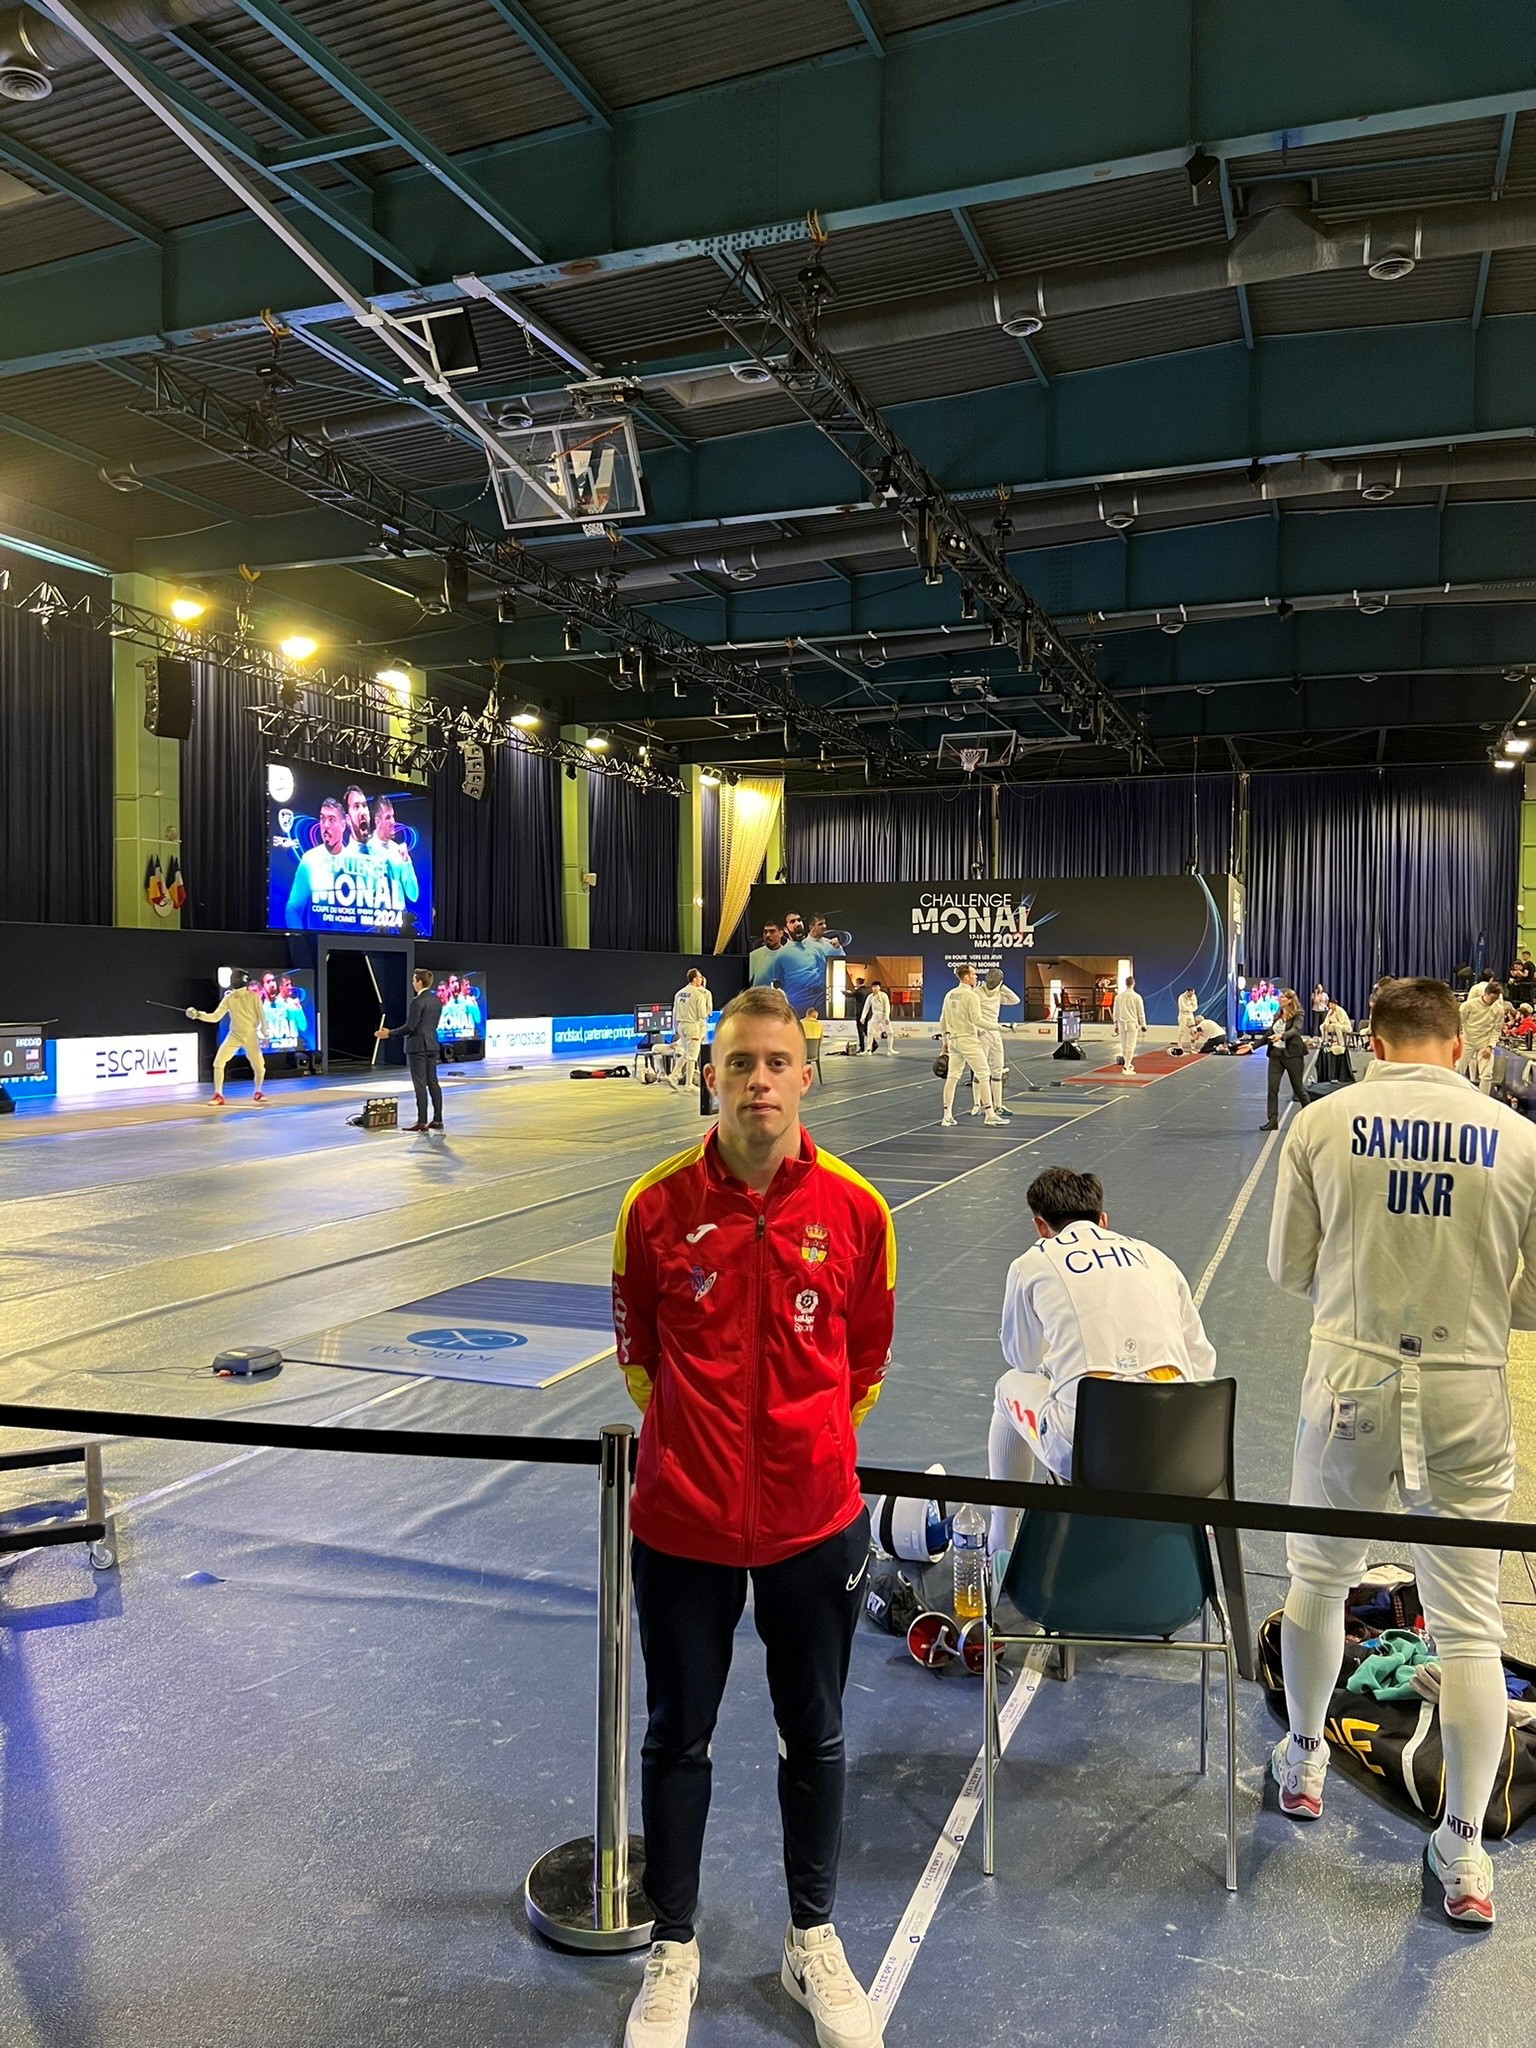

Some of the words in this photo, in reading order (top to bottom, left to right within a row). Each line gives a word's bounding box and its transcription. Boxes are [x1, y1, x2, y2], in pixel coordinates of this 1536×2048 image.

[312, 871, 404, 911] MONAL
[920, 893, 1011, 907] CHALLENGE
[373, 909, 403, 928] 2024
[912, 906, 1034, 934] MONAL
[974, 940, 990, 948] MAI
[992, 933, 1034, 948] 2024
[4, 1050, 13, 1067] 0
[26, 1062, 40, 1070] USA
[96, 1048, 177, 1078] ESCRIME
[1351, 1115, 1499, 1169] SAMOILOV
[1387, 1169, 1454, 1217] UKR
[1065, 1246, 1149, 1274] CHN
[369, 1345, 494, 1362] KABCOM
[870, 1956, 897, 2003] 01.60.35.12.75
